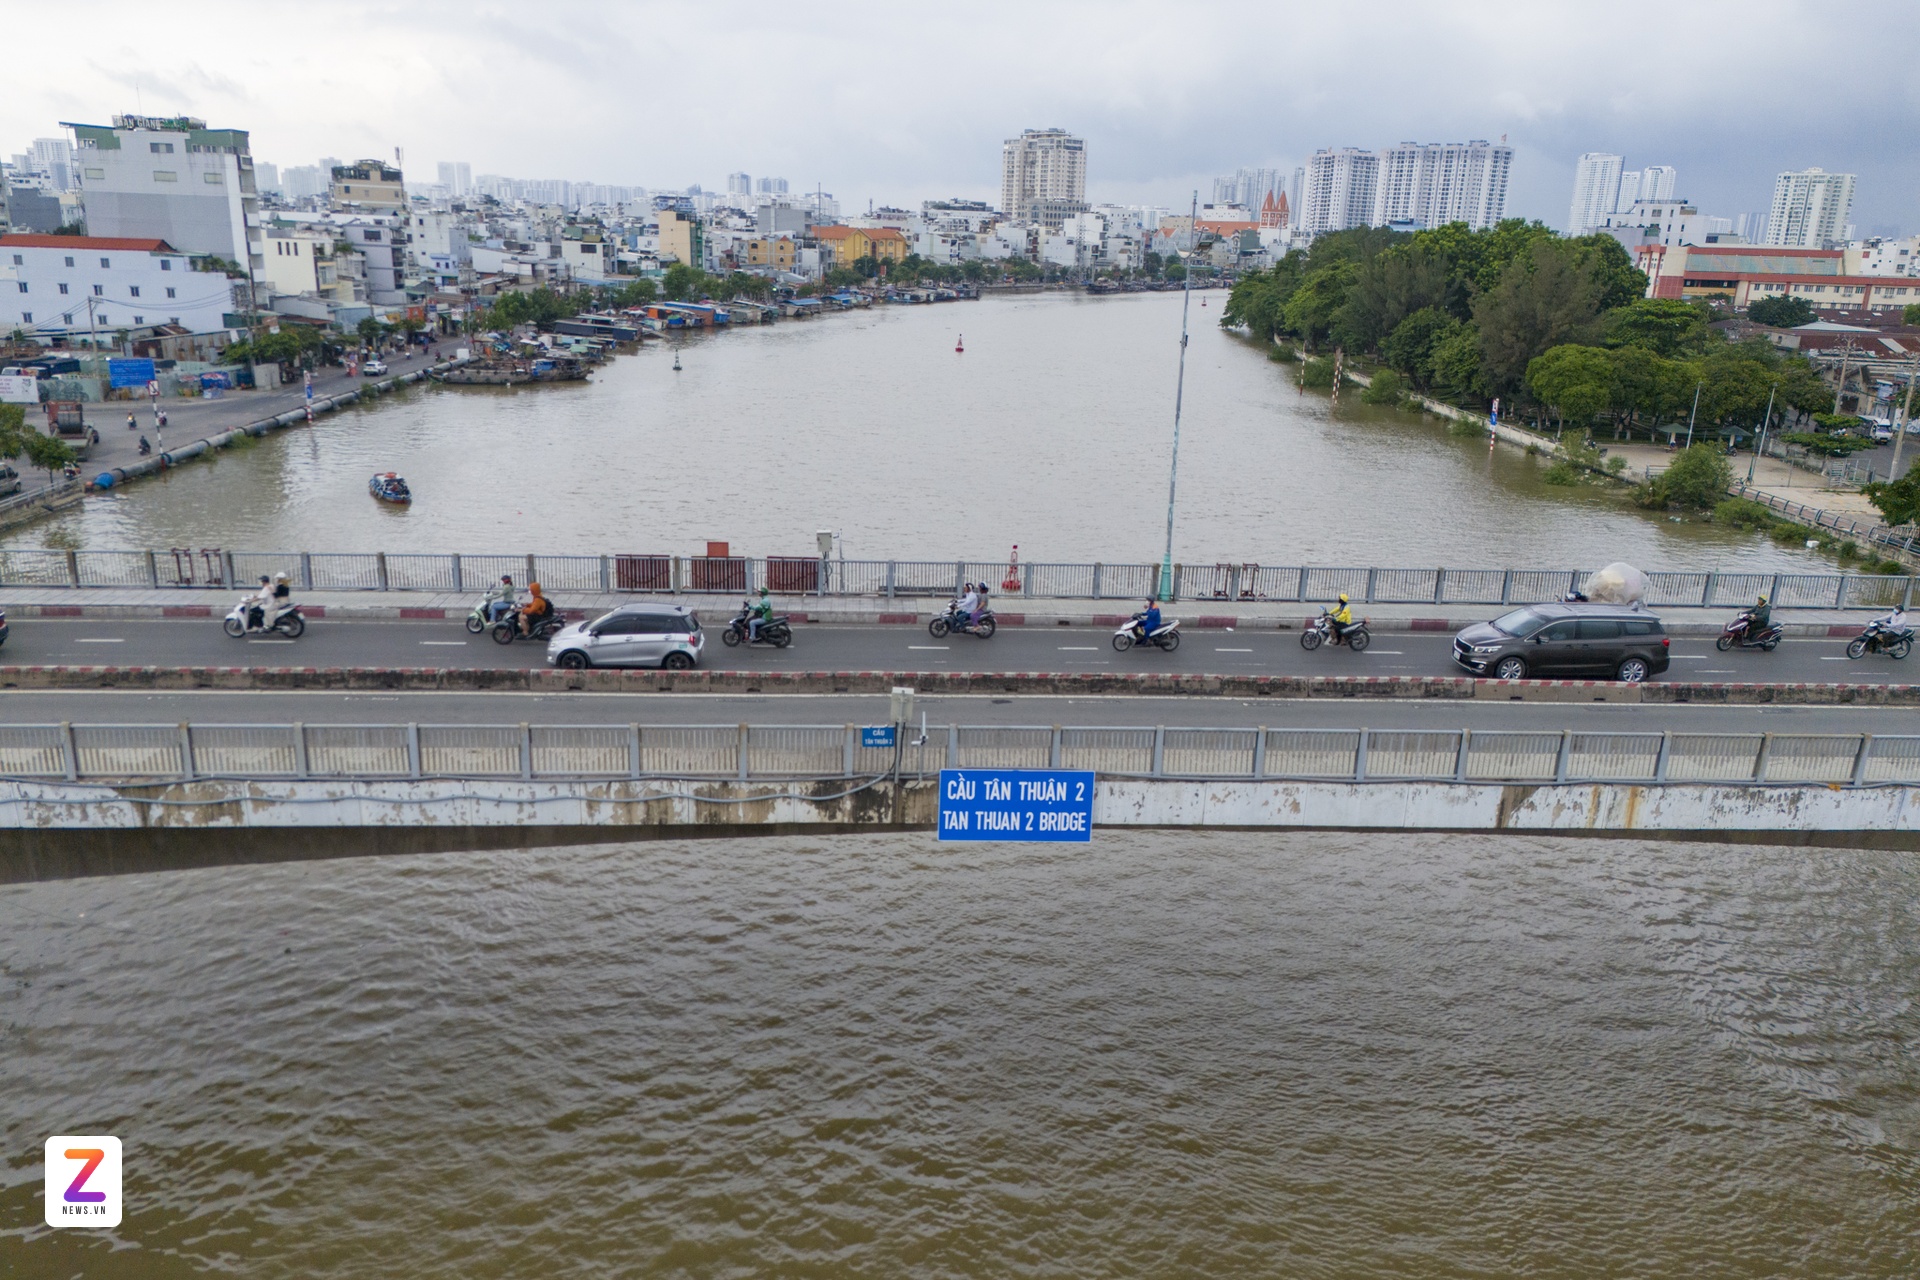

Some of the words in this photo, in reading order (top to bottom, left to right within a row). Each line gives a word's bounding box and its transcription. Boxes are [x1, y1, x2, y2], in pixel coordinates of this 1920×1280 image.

[947, 772, 976, 801] CẦU
[983, 777, 1011, 801] TÂN
[1019, 777, 1067, 805] THUẬN
[1075, 782, 1085, 802] 2
[943, 810, 969, 831] TAN
[975, 811, 1020, 831] THUAN
[1026, 812, 1034, 831] 2
[1039, 812, 1087, 832] BRIDGE
